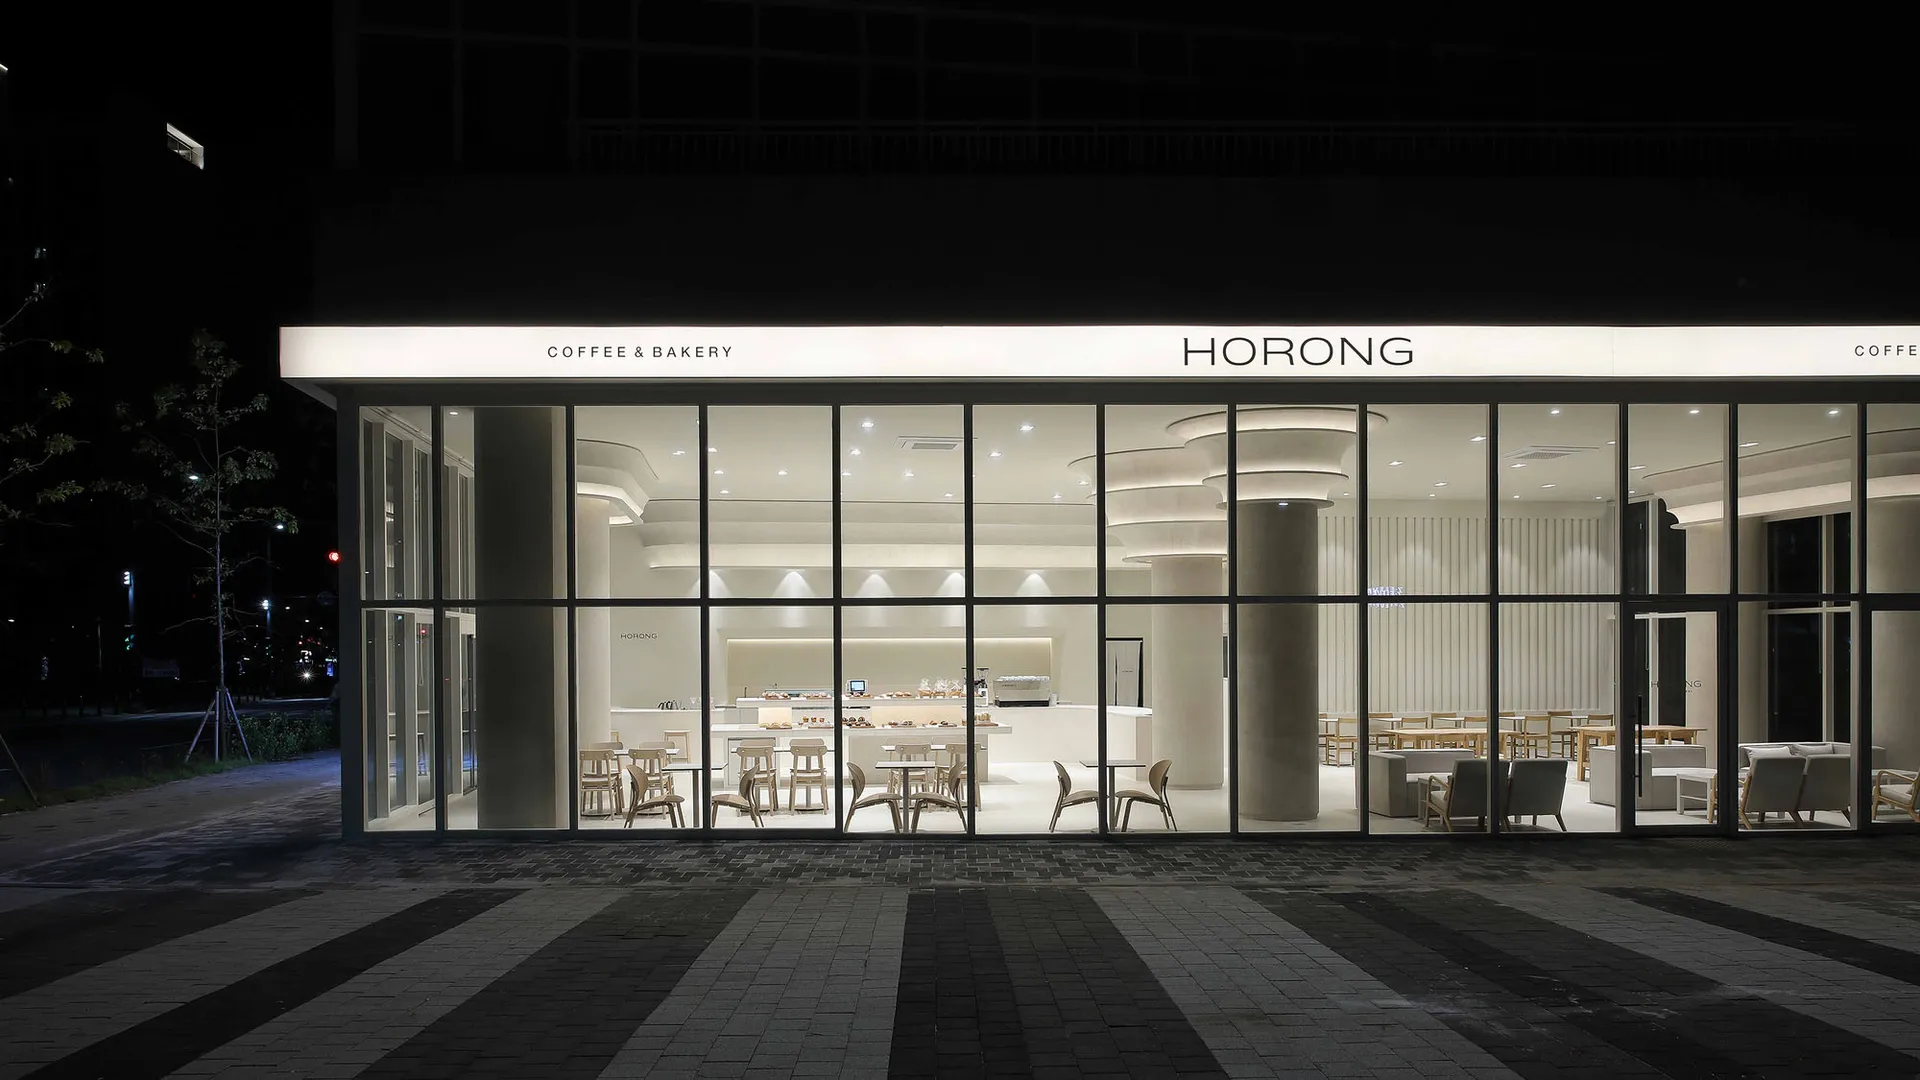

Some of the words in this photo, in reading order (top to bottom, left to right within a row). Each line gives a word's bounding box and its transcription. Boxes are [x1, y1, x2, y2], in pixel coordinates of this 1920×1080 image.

[547, 345, 626, 358] COFFEE
[634, 345, 644, 358] &
[652, 346, 732, 358] BAKERY
[1183, 336, 1413, 367] HORONG
